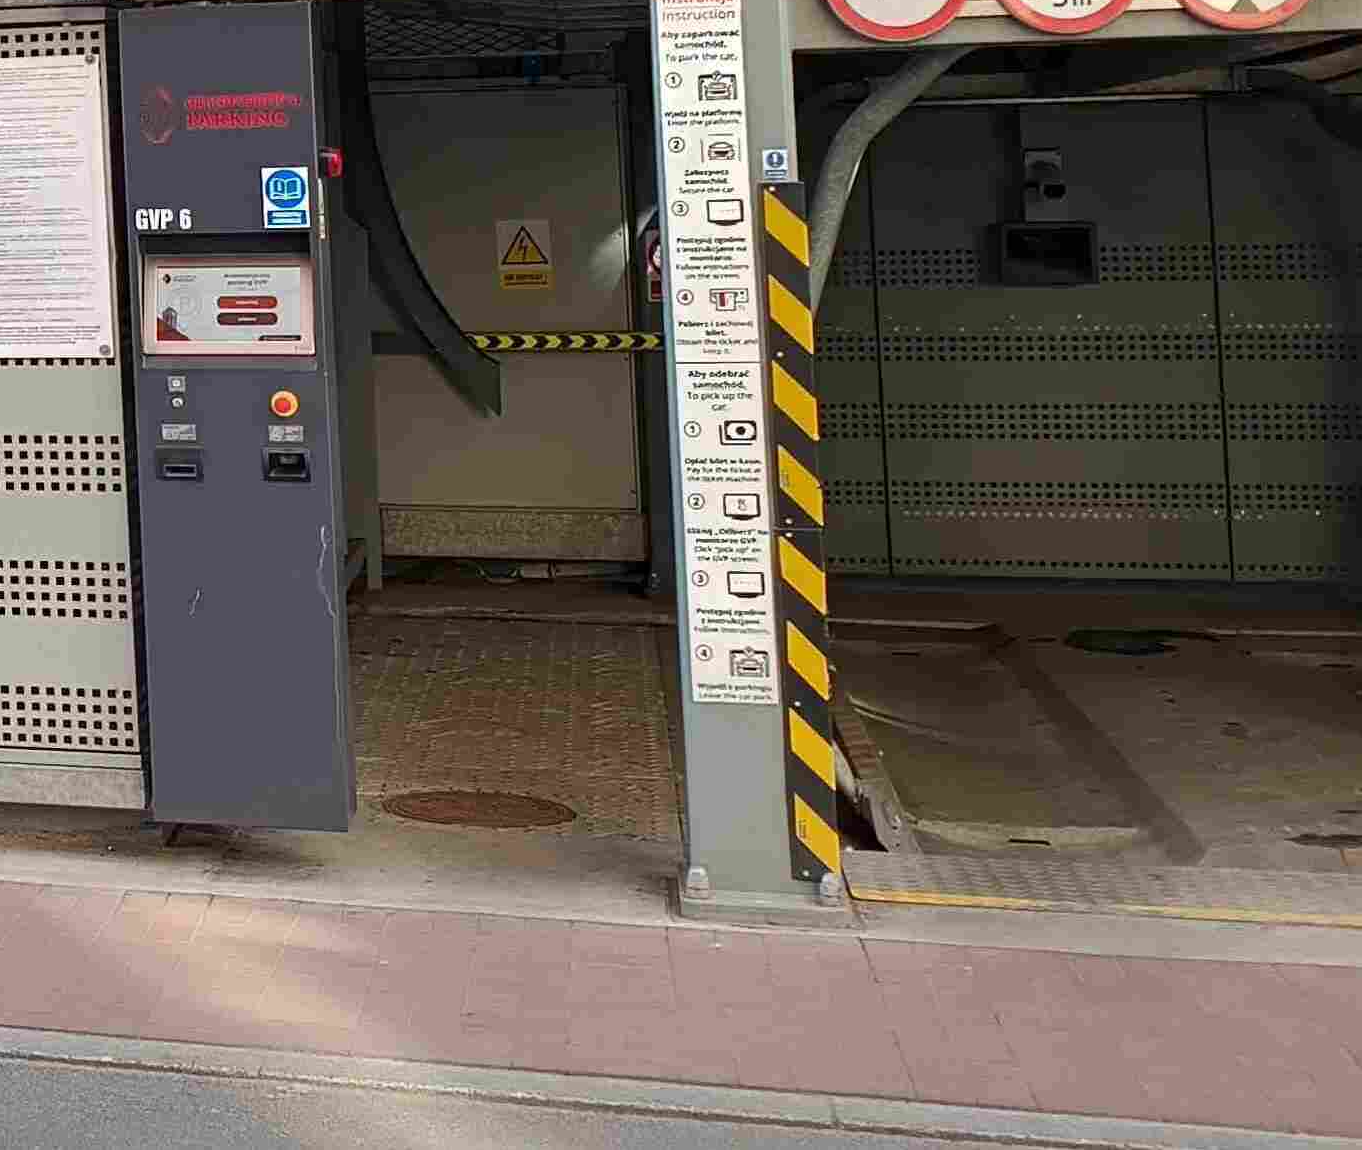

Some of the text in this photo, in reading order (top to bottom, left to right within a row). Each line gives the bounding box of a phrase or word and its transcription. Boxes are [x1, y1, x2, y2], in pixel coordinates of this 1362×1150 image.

[661, 8, 735, 22] Instruction
[135, 208, 192, 231] GVP 6
